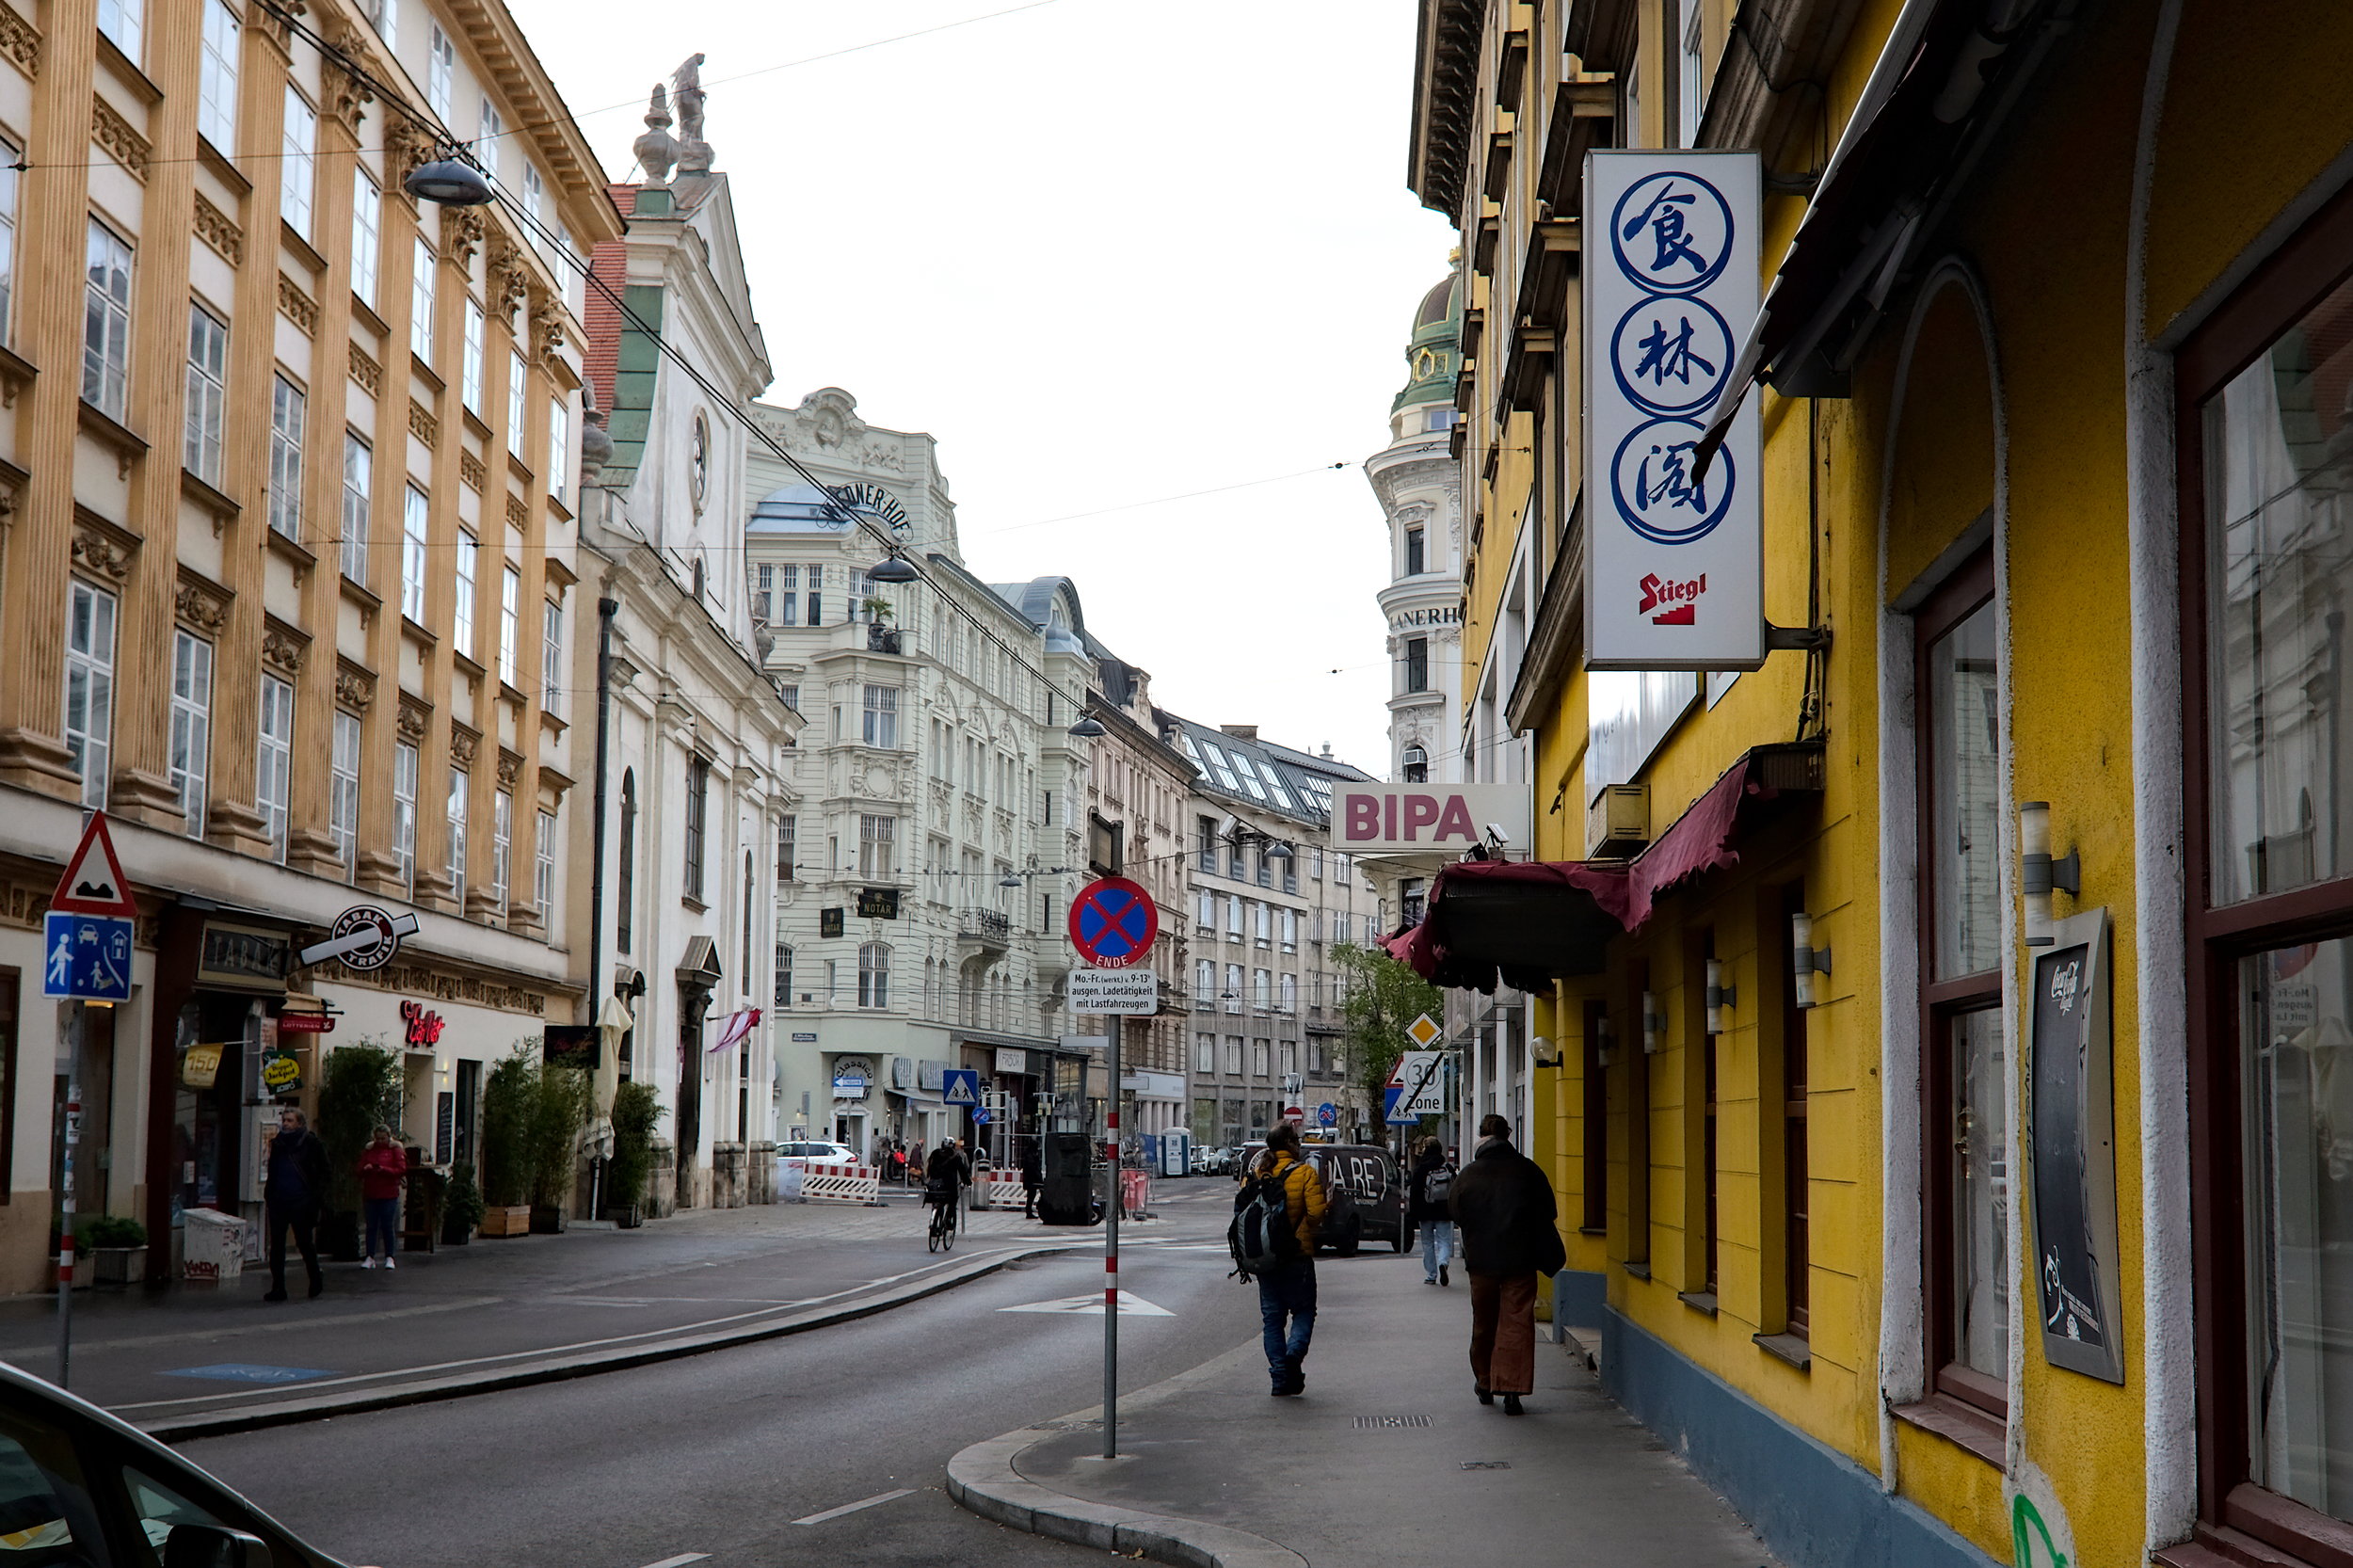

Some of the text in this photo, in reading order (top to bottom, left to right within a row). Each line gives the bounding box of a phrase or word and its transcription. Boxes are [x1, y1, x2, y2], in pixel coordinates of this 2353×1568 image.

[1640, 572, 1707, 615] Stiegl
[1345, 793, 1479, 841] BIPA
[864, 903, 891, 914] NOTAR
[336, 910, 382, 936] TABAK
[347, 935, 393, 967] TRAFIK
[1096, 954, 1129, 968] ENDE
[1075, 974, 1100, 984] Mo.-Fr.
[1072, 985, 1153, 998] ausgen. Ladetätigkeit
[1076, 998, 1149, 1010] mit Lastfahrzeugen
[836, 1061, 873, 1080] Classico
[1412, 1064, 1436, 1086] 30
